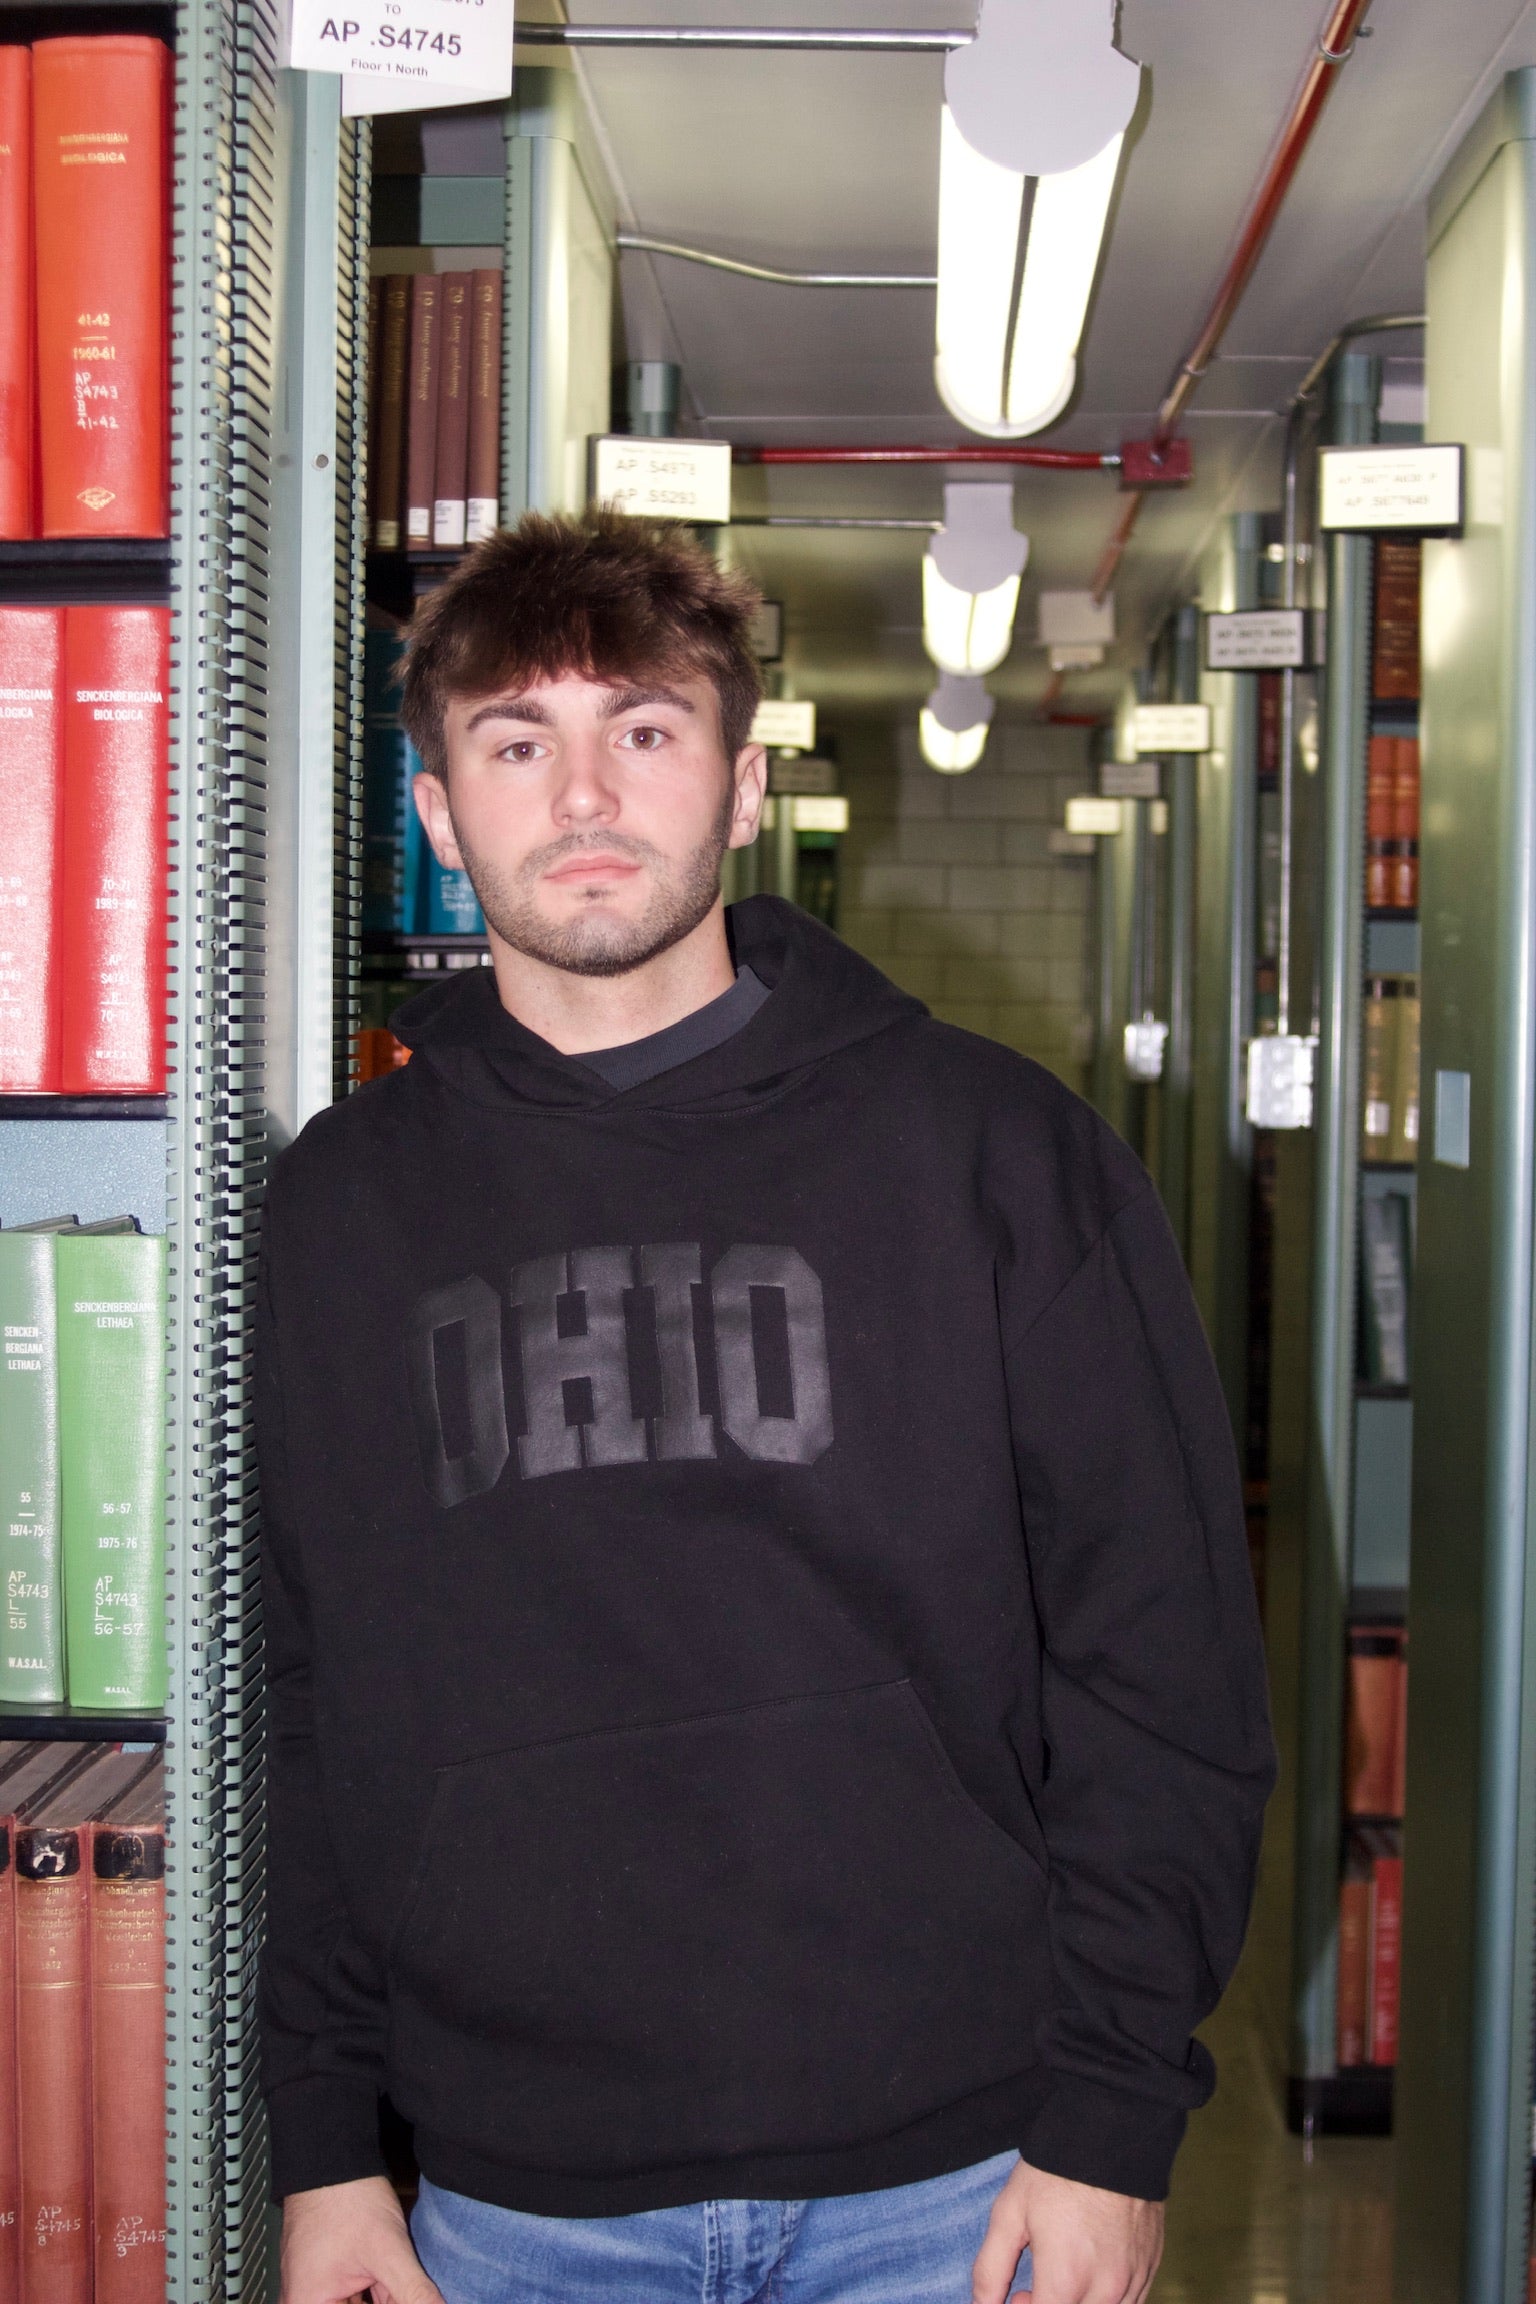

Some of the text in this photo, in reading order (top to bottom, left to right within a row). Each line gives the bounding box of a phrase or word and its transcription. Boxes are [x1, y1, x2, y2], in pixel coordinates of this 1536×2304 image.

[385, 4, 401, 15] TO
[320, 18, 462, 56] AP .S4745
[351, 58, 428, 77] Floor 1 North
[76, 690, 163, 703] SENCKENBERGIANA
[93, 709, 144, 721] BIOLOGICA
[74, 1302, 157, 1313] SENCKENBERGIANA
[97, 1317, 134, 1328] LETHAEA
[5, 1343, 44, 1354] BERGIANA
[8, 1360, 42, 1371] LETHAEA
[404, 1242, 833, 1508] OHIO
[20, 1492, 31, 1503] 55
[103, 1503, 131, 1514] 56-57
[9, 1524, 44, 1537] 1974-75
[98, 1537, 137, 1549] 1975-76
[8, 1571, 27, 1583] AP
[95, 1575, 113, 1592] AP
[9, 1618, 28, 1630] 55
[94, 1623, 143, 1636] 56-57
[116, 2216, 143, 2230] AP
[38, 2236, 46, 2247] 8
